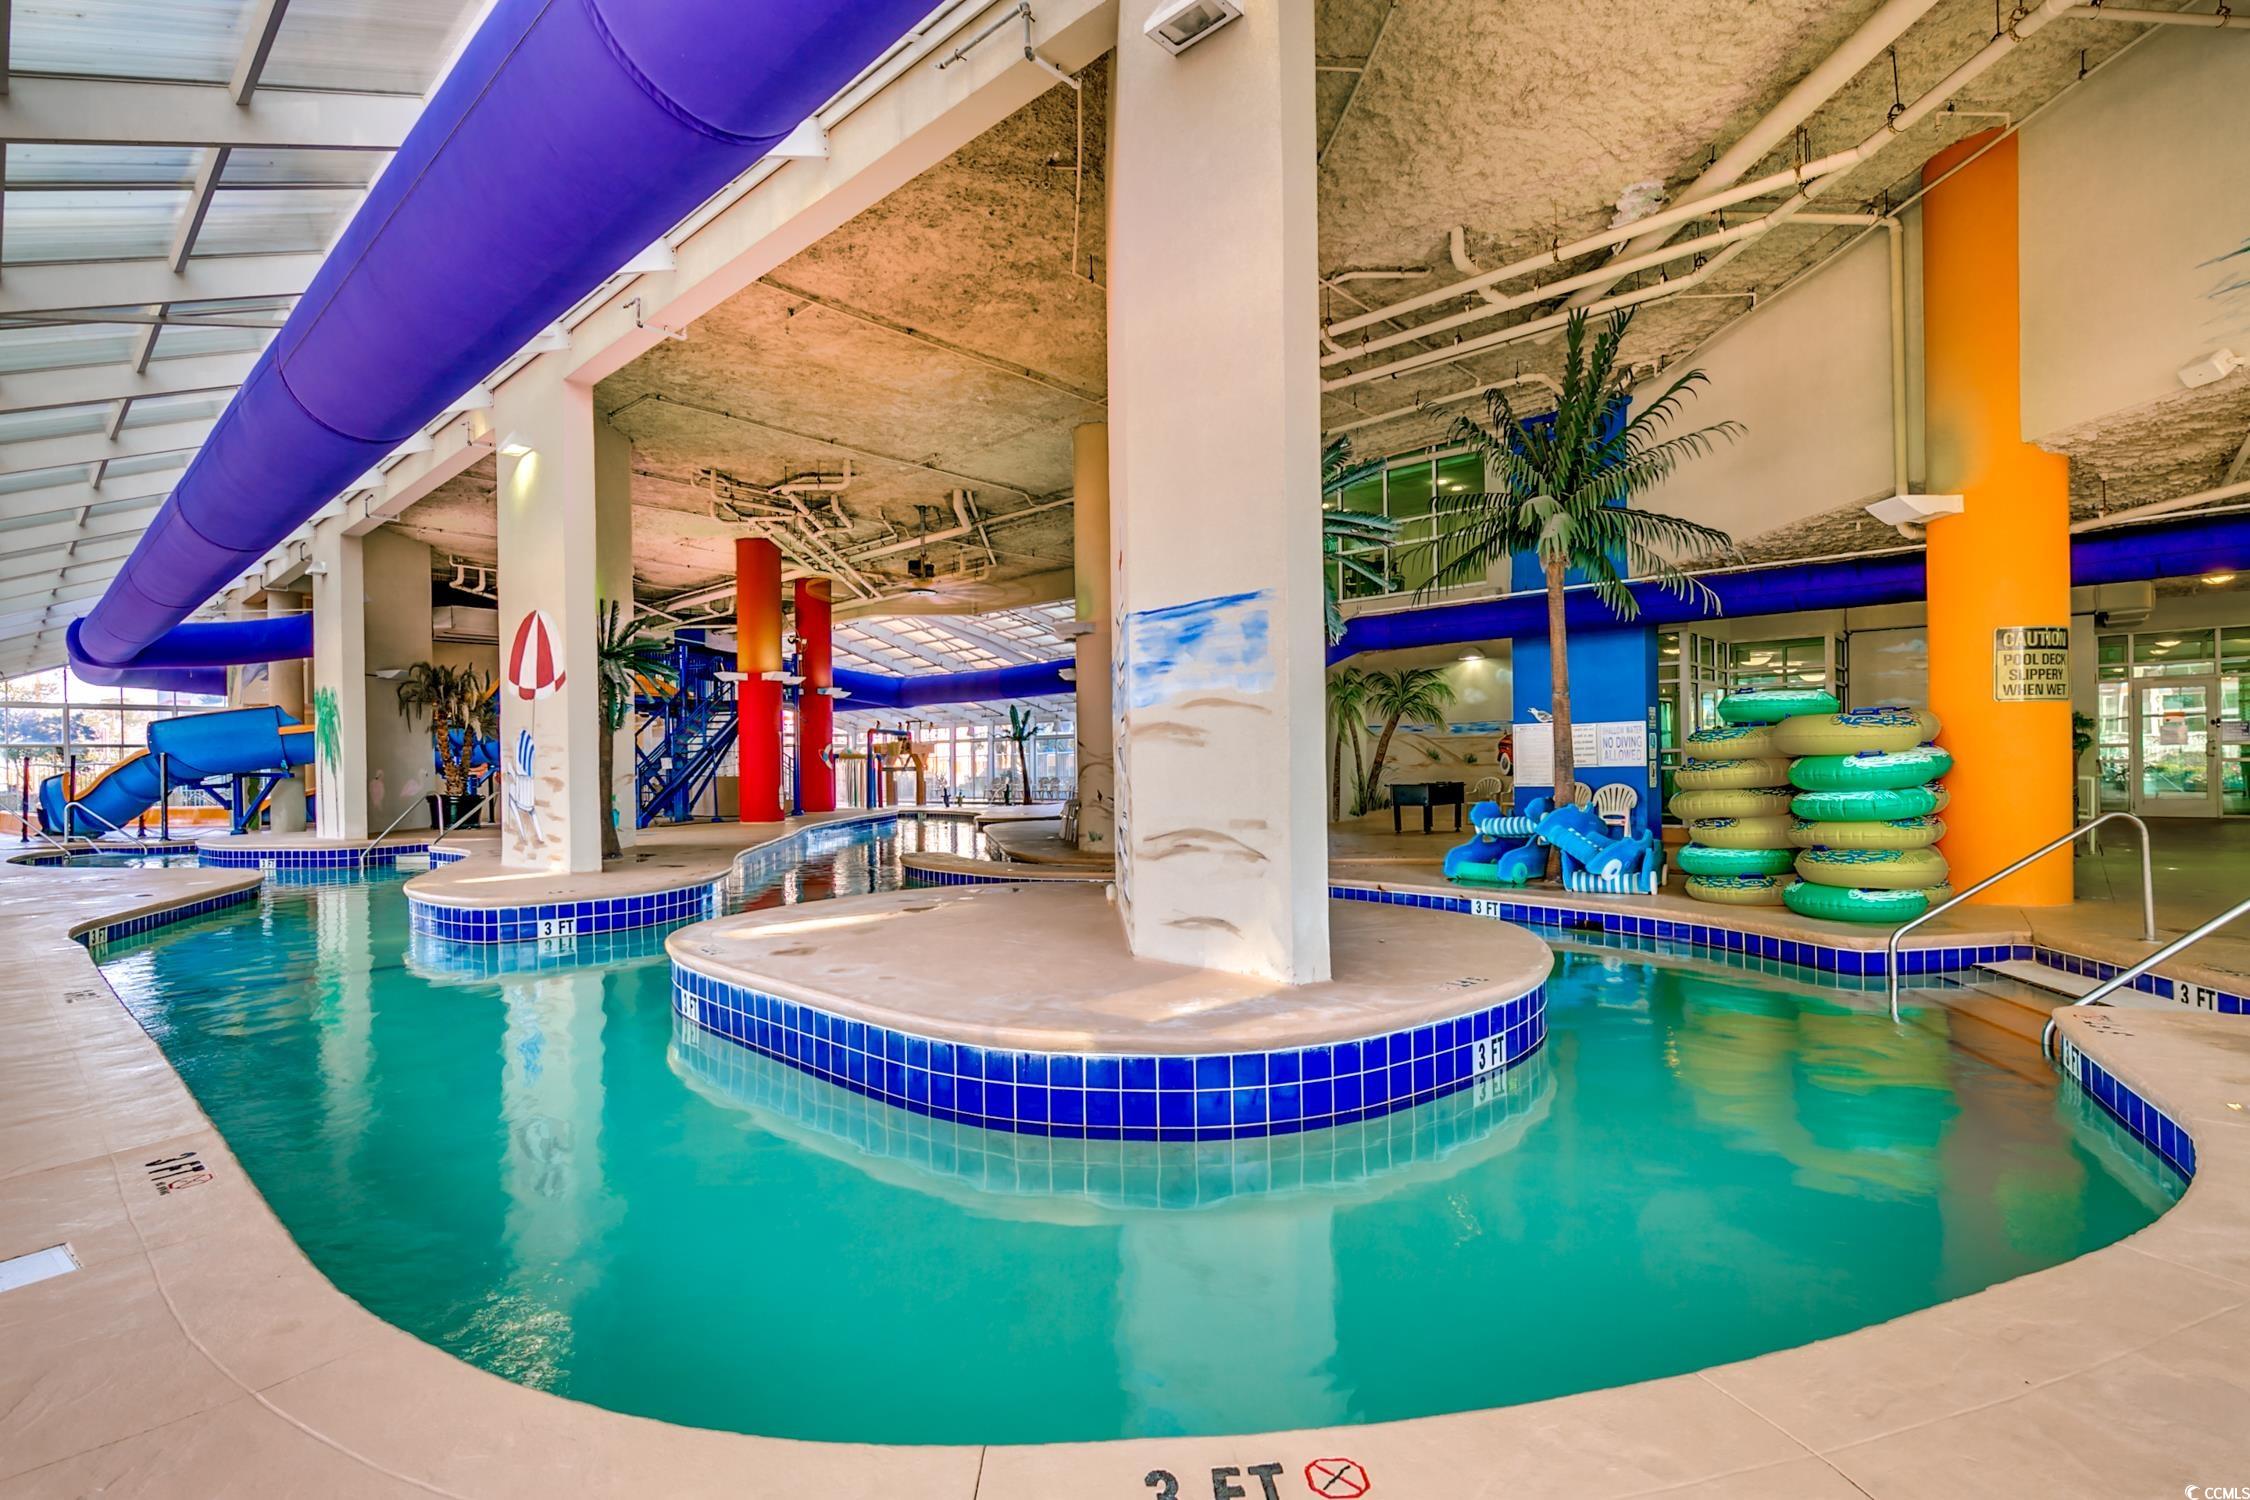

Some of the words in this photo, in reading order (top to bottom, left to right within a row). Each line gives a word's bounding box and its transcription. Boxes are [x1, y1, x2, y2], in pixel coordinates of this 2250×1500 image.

[2003, 630, 2067, 647] CAUTION
[2003, 653, 2039, 666] POOL
[2042, 653, 2066, 665] DECK
[2008, 668, 2064, 680] SLIPPERY
[2003, 683, 2043, 696] WHEN
[2046, 683, 2067, 695] WET
[1602, 736, 1614, 748] NO
[1615, 735, 1642, 748] DIVING
[1603, 749, 1642, 761] ALLOWED
[1475, 900, 1482, 914] 3
[1486, 901, 1498, 916] FT
[91, 929, 96, 944] 3
[98, 926, 106, 943] FT
[544, 921, 552, 936] 3
[558, 919, 574, 935] FT
[2180, 983, 2189, 1004] 3
[2196, 986, 2216, 1011] FT
[1478, 1042, 1486, 1070] 3
[1491, 1034, 1504, 1066] FT
[2071, 1044, 2080, 1077] FT
[145, 1151, 197, 1167] 3
[1144, 1469, 1179, 1500] 3
[1210, 1462, 1284, 1500] FT
